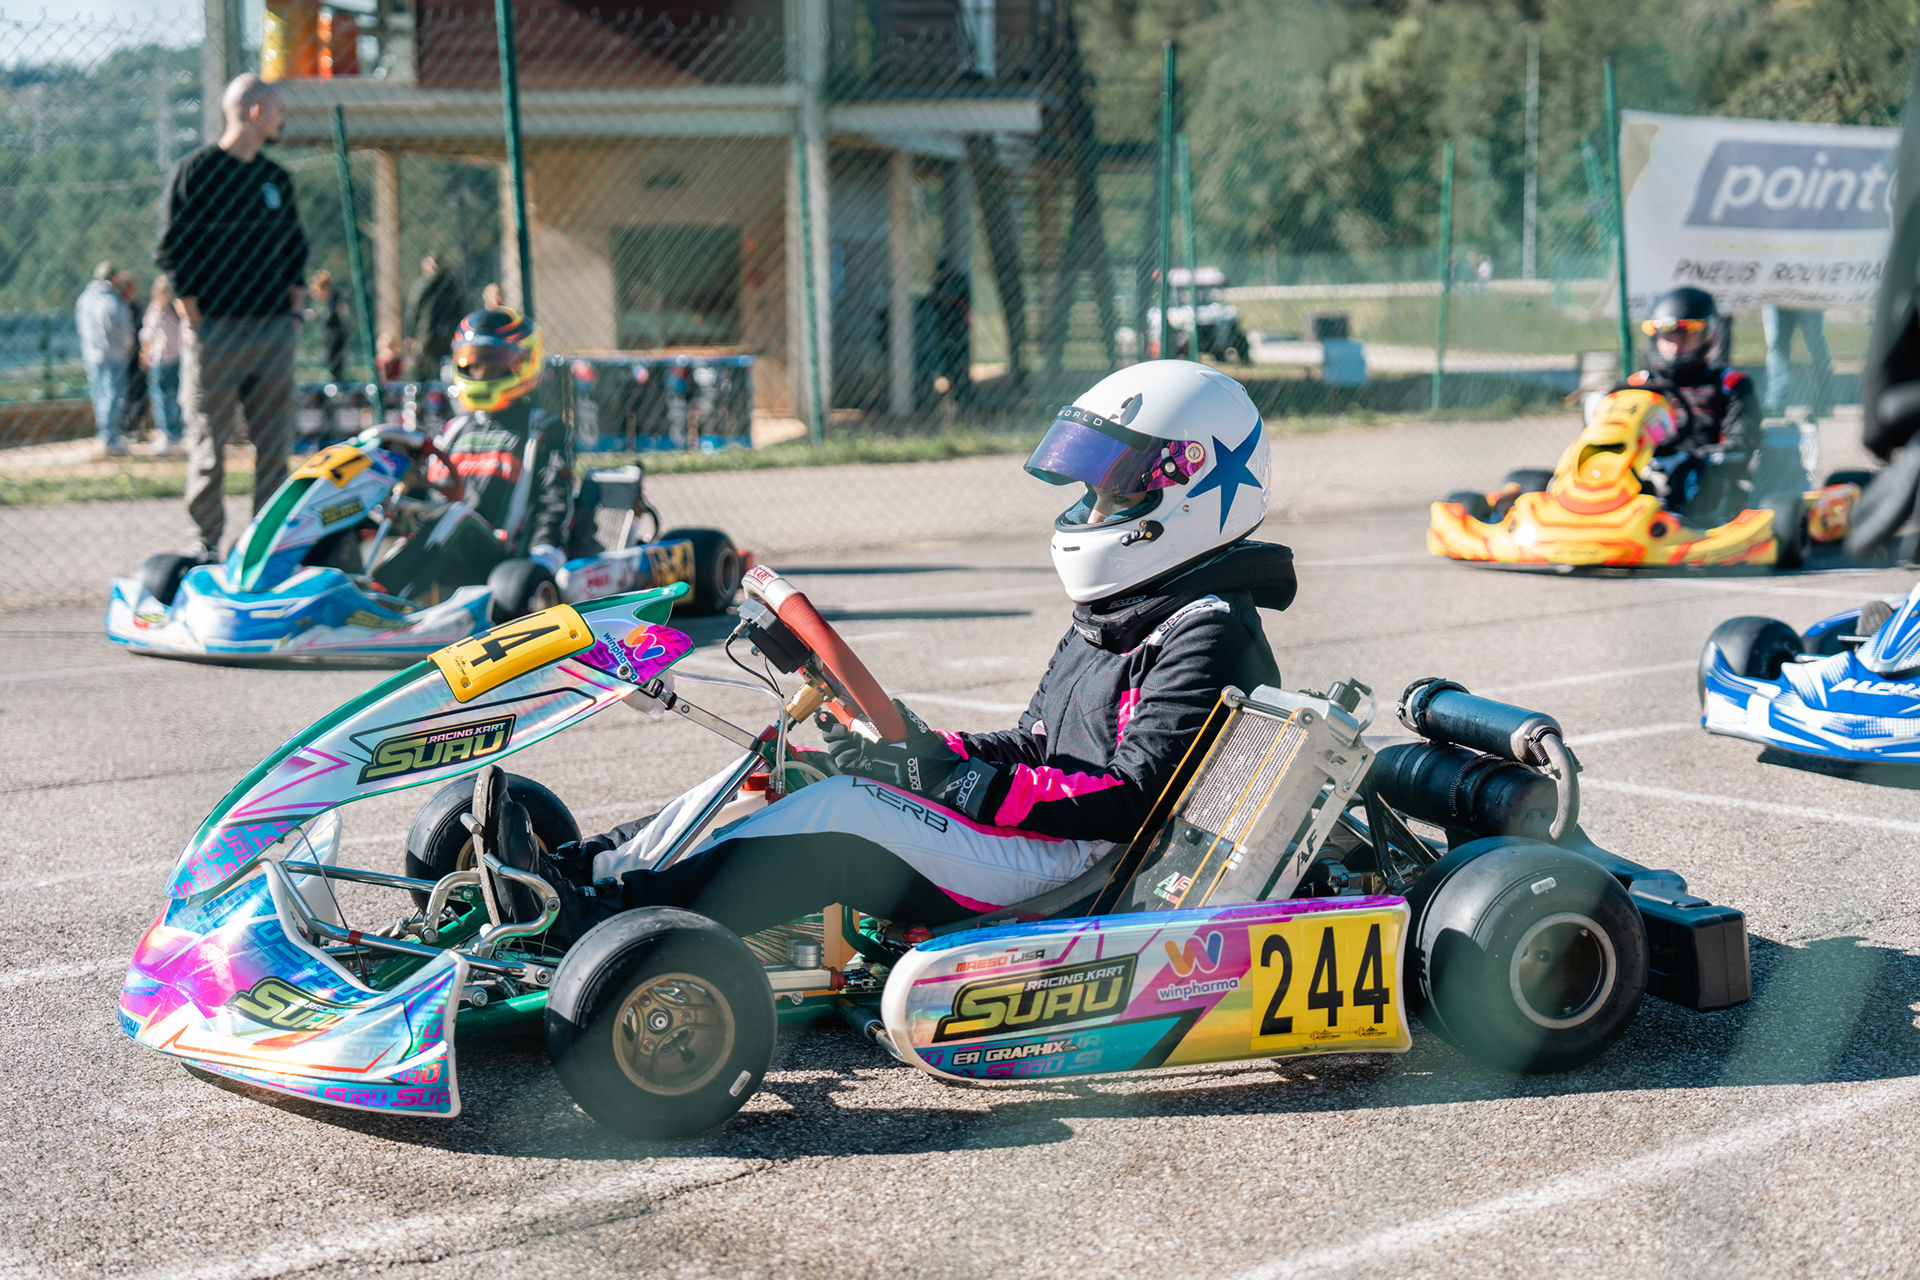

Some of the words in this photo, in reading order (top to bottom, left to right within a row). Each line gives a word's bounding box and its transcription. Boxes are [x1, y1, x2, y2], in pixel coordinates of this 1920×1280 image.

[366, 730, 505, 778] SUAU
[1009, 948, 1046, 965] LISA
[1025, 972, 1084, 991] RACING
[1159, 977, 1239, 1001] winpharma
[1259, 923, 1391, 1036] 244
[943, 976, 1124, 1036] SUAU
